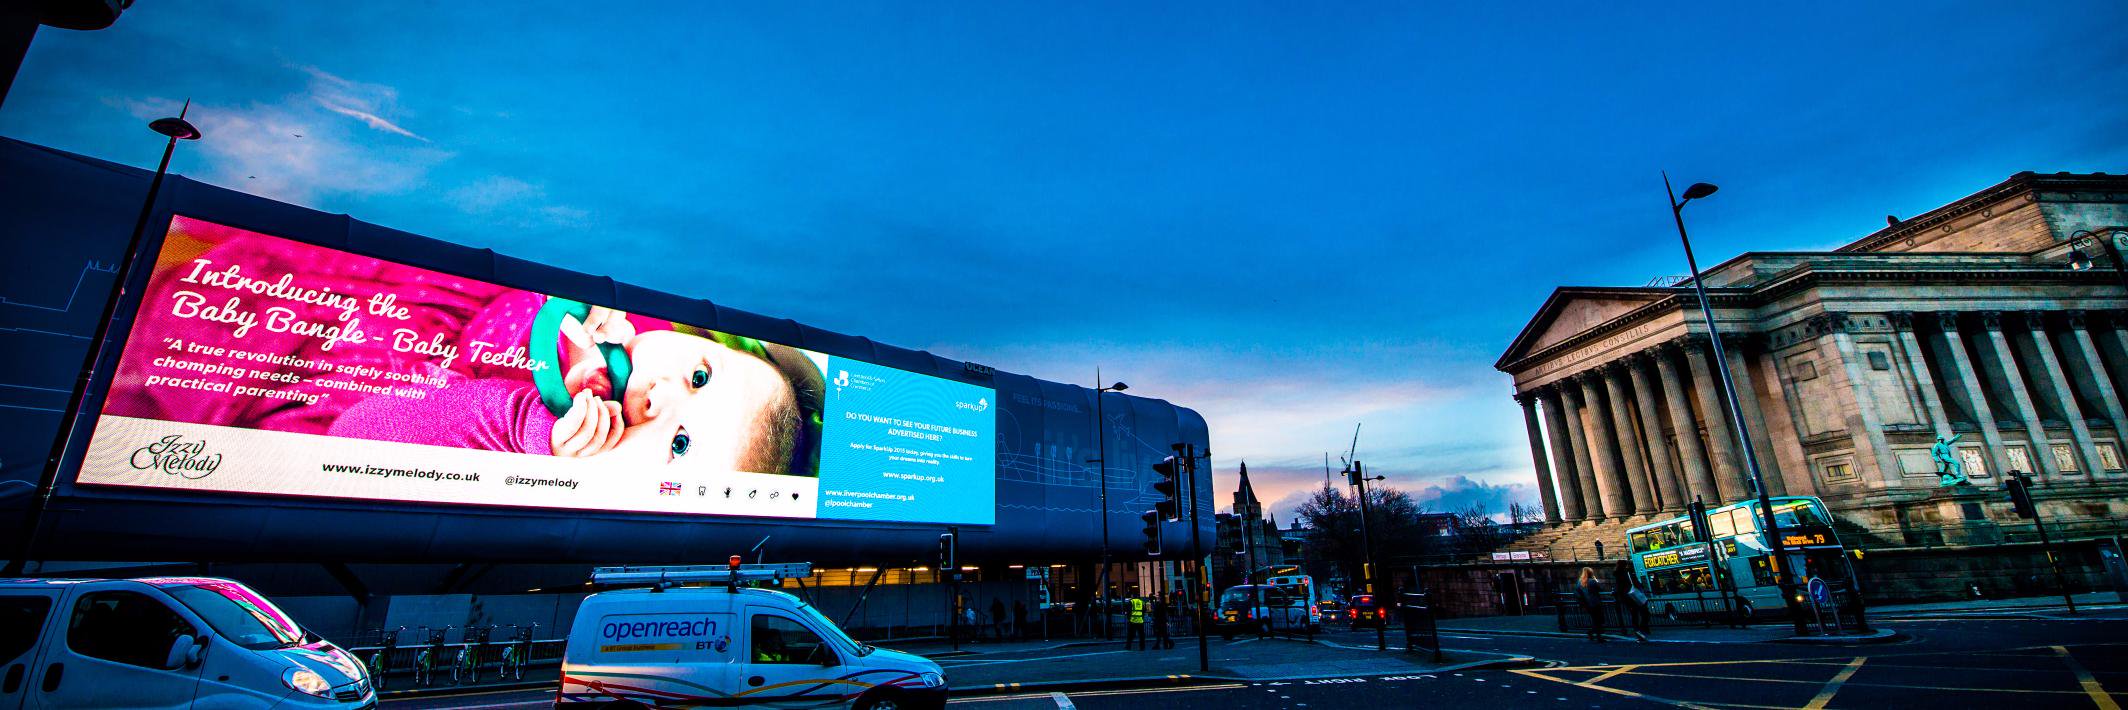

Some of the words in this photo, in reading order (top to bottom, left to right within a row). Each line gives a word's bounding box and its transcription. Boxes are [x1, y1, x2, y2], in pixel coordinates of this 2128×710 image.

[180, 259, 359, 321] Introducing
[368, 293, 411, 320] the
[172, 291, 258, 338] Baby
[266, 307, 366, 351] Bangle
[393, 328, 459, 369] Baby
[470, 341, 550, 371] Teether
[188, 341, 225, 357] true
[228, 349, 315, 369] revolution
[318, 360, 332, 372] in
[336, 364, 382, 380] safely
[385, 371, 450, 389] soothing,
[145, 375, 233, 393] practical
[153, 356, 246, 379] chomping
[249, 369, 300, 384] needs
[315, 378, 393, 396] combined
[395, 386, 426, 400] with
[955, 400, 983, 413] sparkup
[846, 412, 857, 420] DO
[858, 414, 872, 422] YOU
[873, 416, 892, 424] WANT
[903, 420, 913, 428] SEE
[914, 422, 930, 430] YOUR
[931, 425, 952, 434] FUTURE
[953, 428, 978, 438] BUSINESS
[888, 428, 924, 439] ADVERTISED
[926, 433, 943, 442] HERE?
[148, 435, 206, 457] Izzy
[130, 447, 222, 479] Melody
[322, 463, 480, 482] www.izzymelody.co.uk
[883, 472, 944, 483] www.sparkup.org.uk
[504, 475, 579, 490] @izzymelody
[825, 489, 915, 501] www.liverpoolchamber.org.uk
[824, 499, 873, 509] @lpoolchamber
[1813, 534, 1825, 544] 79
[1643, 553, 1680, 569] FOXCATCHER
[603, 617, 717, 642] openreach
[695, 641, 714, 650] BT
[1304, 677, 1367, 685] RIGHT
